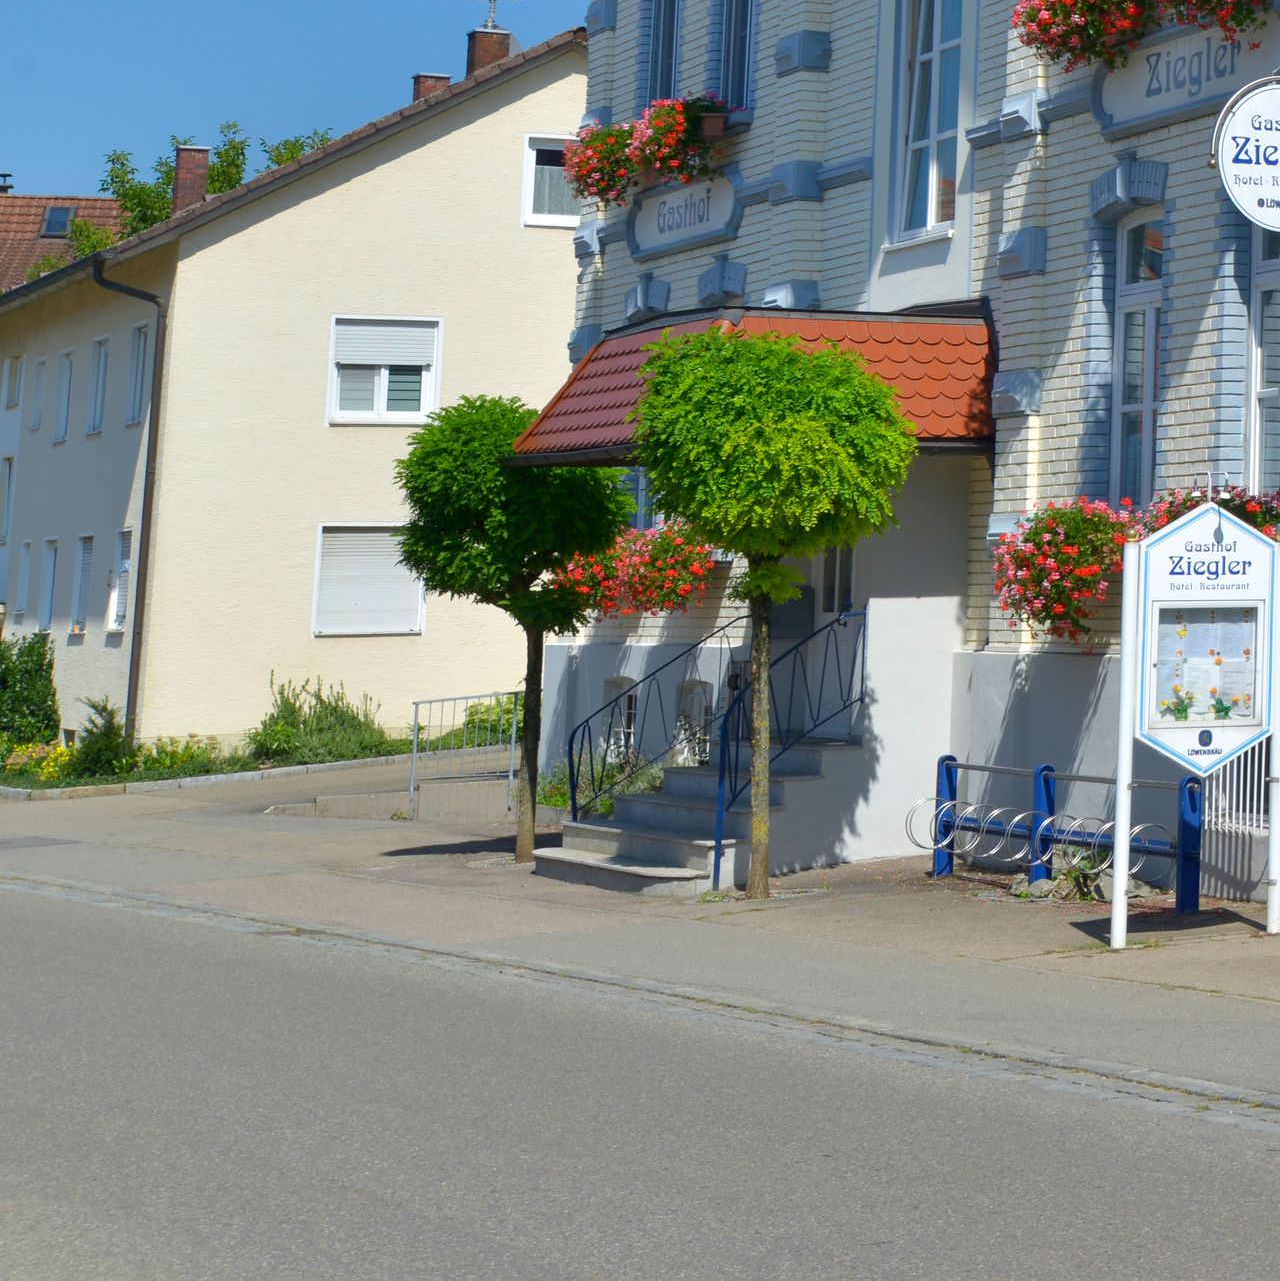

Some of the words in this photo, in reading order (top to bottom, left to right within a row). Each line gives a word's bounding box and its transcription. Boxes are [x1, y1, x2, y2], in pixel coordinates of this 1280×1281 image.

[1145, 36, 1242, 99] Ziegler
[656, 187, 712, 235] Gasthof
[1184, 540, 1239, 553] Gasthof
[1168, 555, 1253, 581] Ziegler
[1199, 582, 1250, 591] Restaurant
